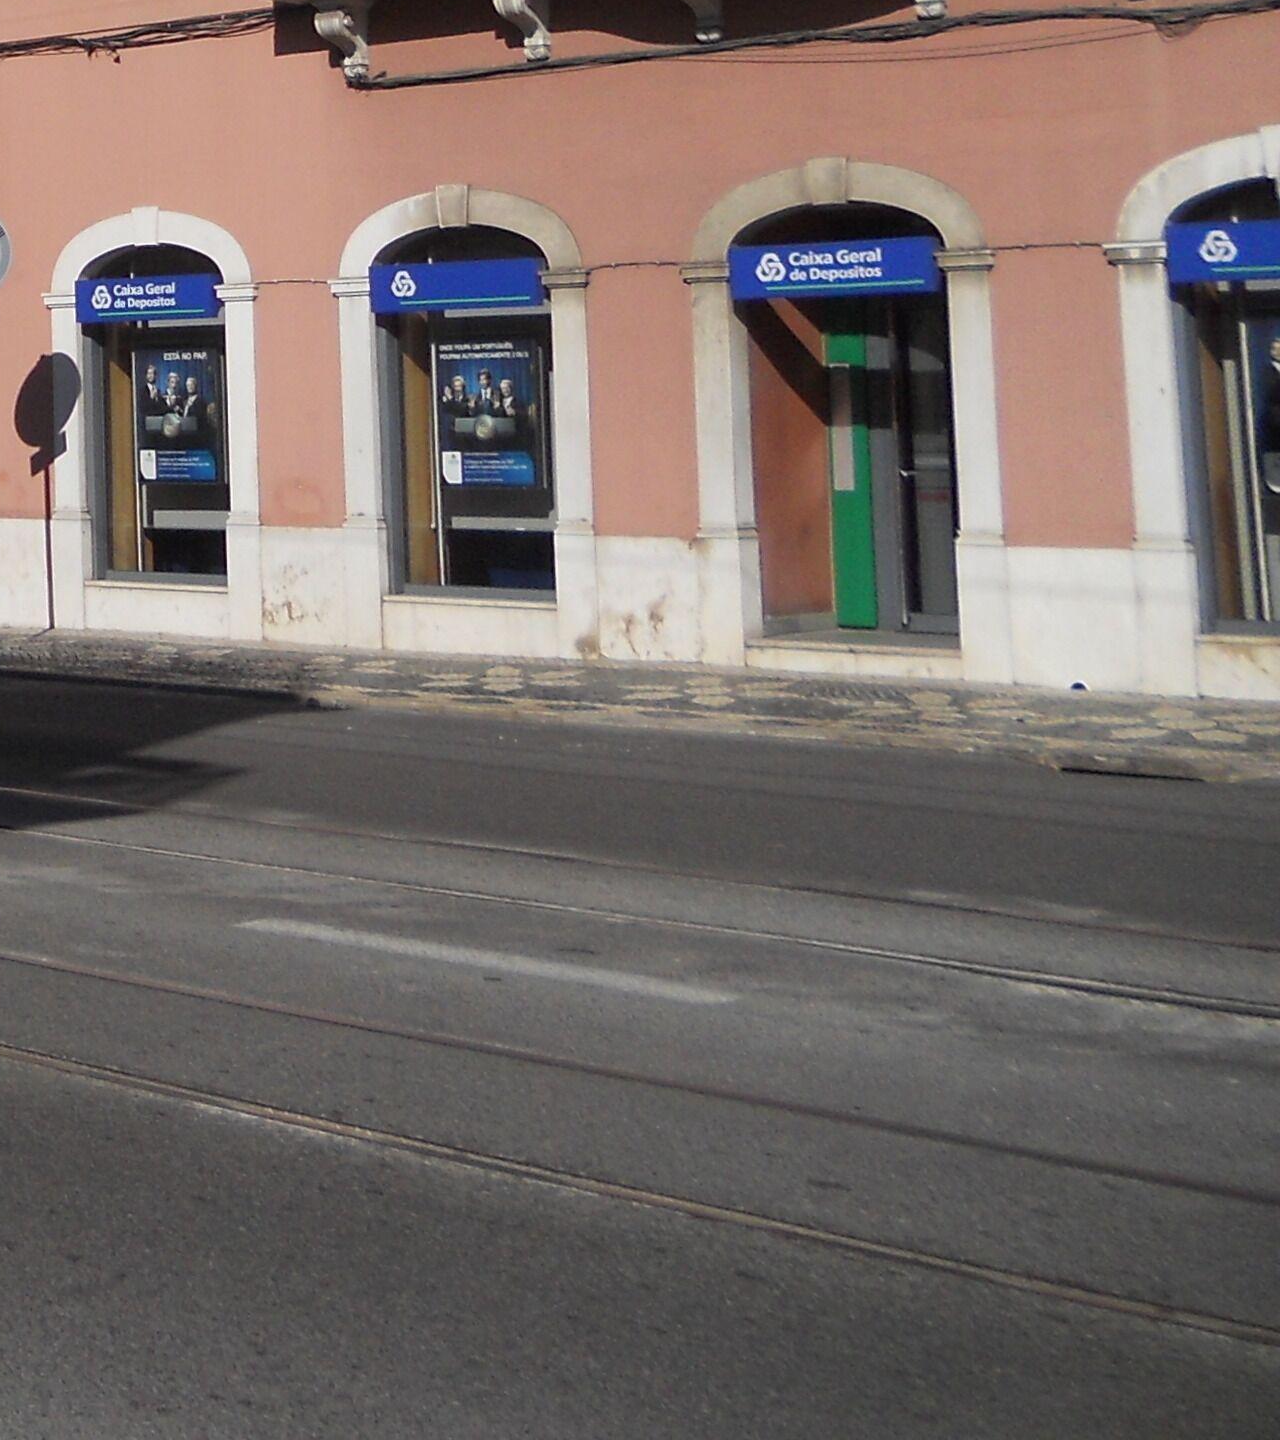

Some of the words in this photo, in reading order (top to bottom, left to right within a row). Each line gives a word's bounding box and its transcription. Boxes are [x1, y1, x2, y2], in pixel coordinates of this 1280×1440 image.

[788, 251, 833, 266] Caixa
[835, 248, 882, 264] Geral
[789, 268, 808, 281] de
[113, 283, 144, 296] Caixa
[145, 282, 175, 295] Geral
[113, 297, 126, 309] de
